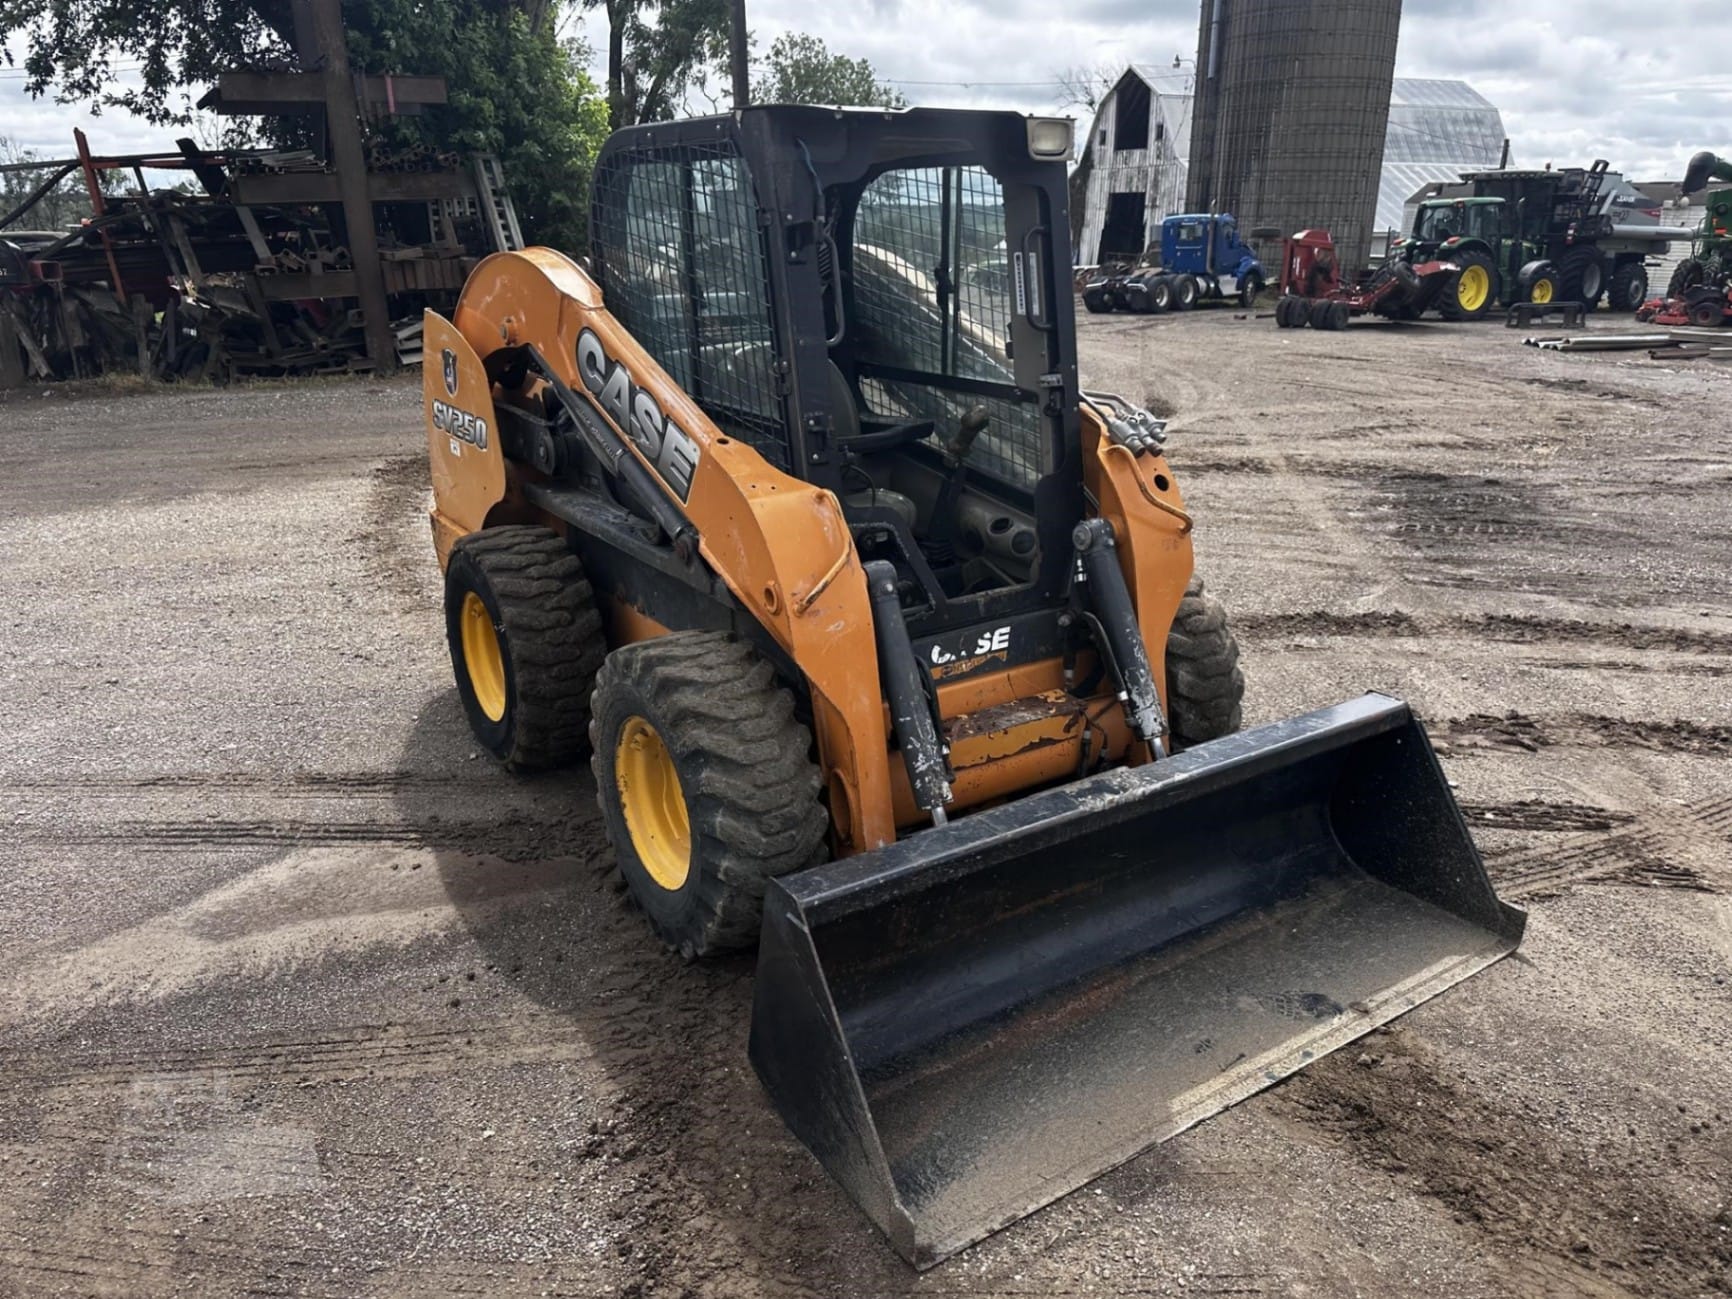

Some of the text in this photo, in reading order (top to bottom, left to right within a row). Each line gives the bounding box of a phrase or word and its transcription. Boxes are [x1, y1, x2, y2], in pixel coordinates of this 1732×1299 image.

[432, 399, 487, 449] SV250
[577, 329, 694, 500] CASE
[931, 626, 1011, 664] CSE
